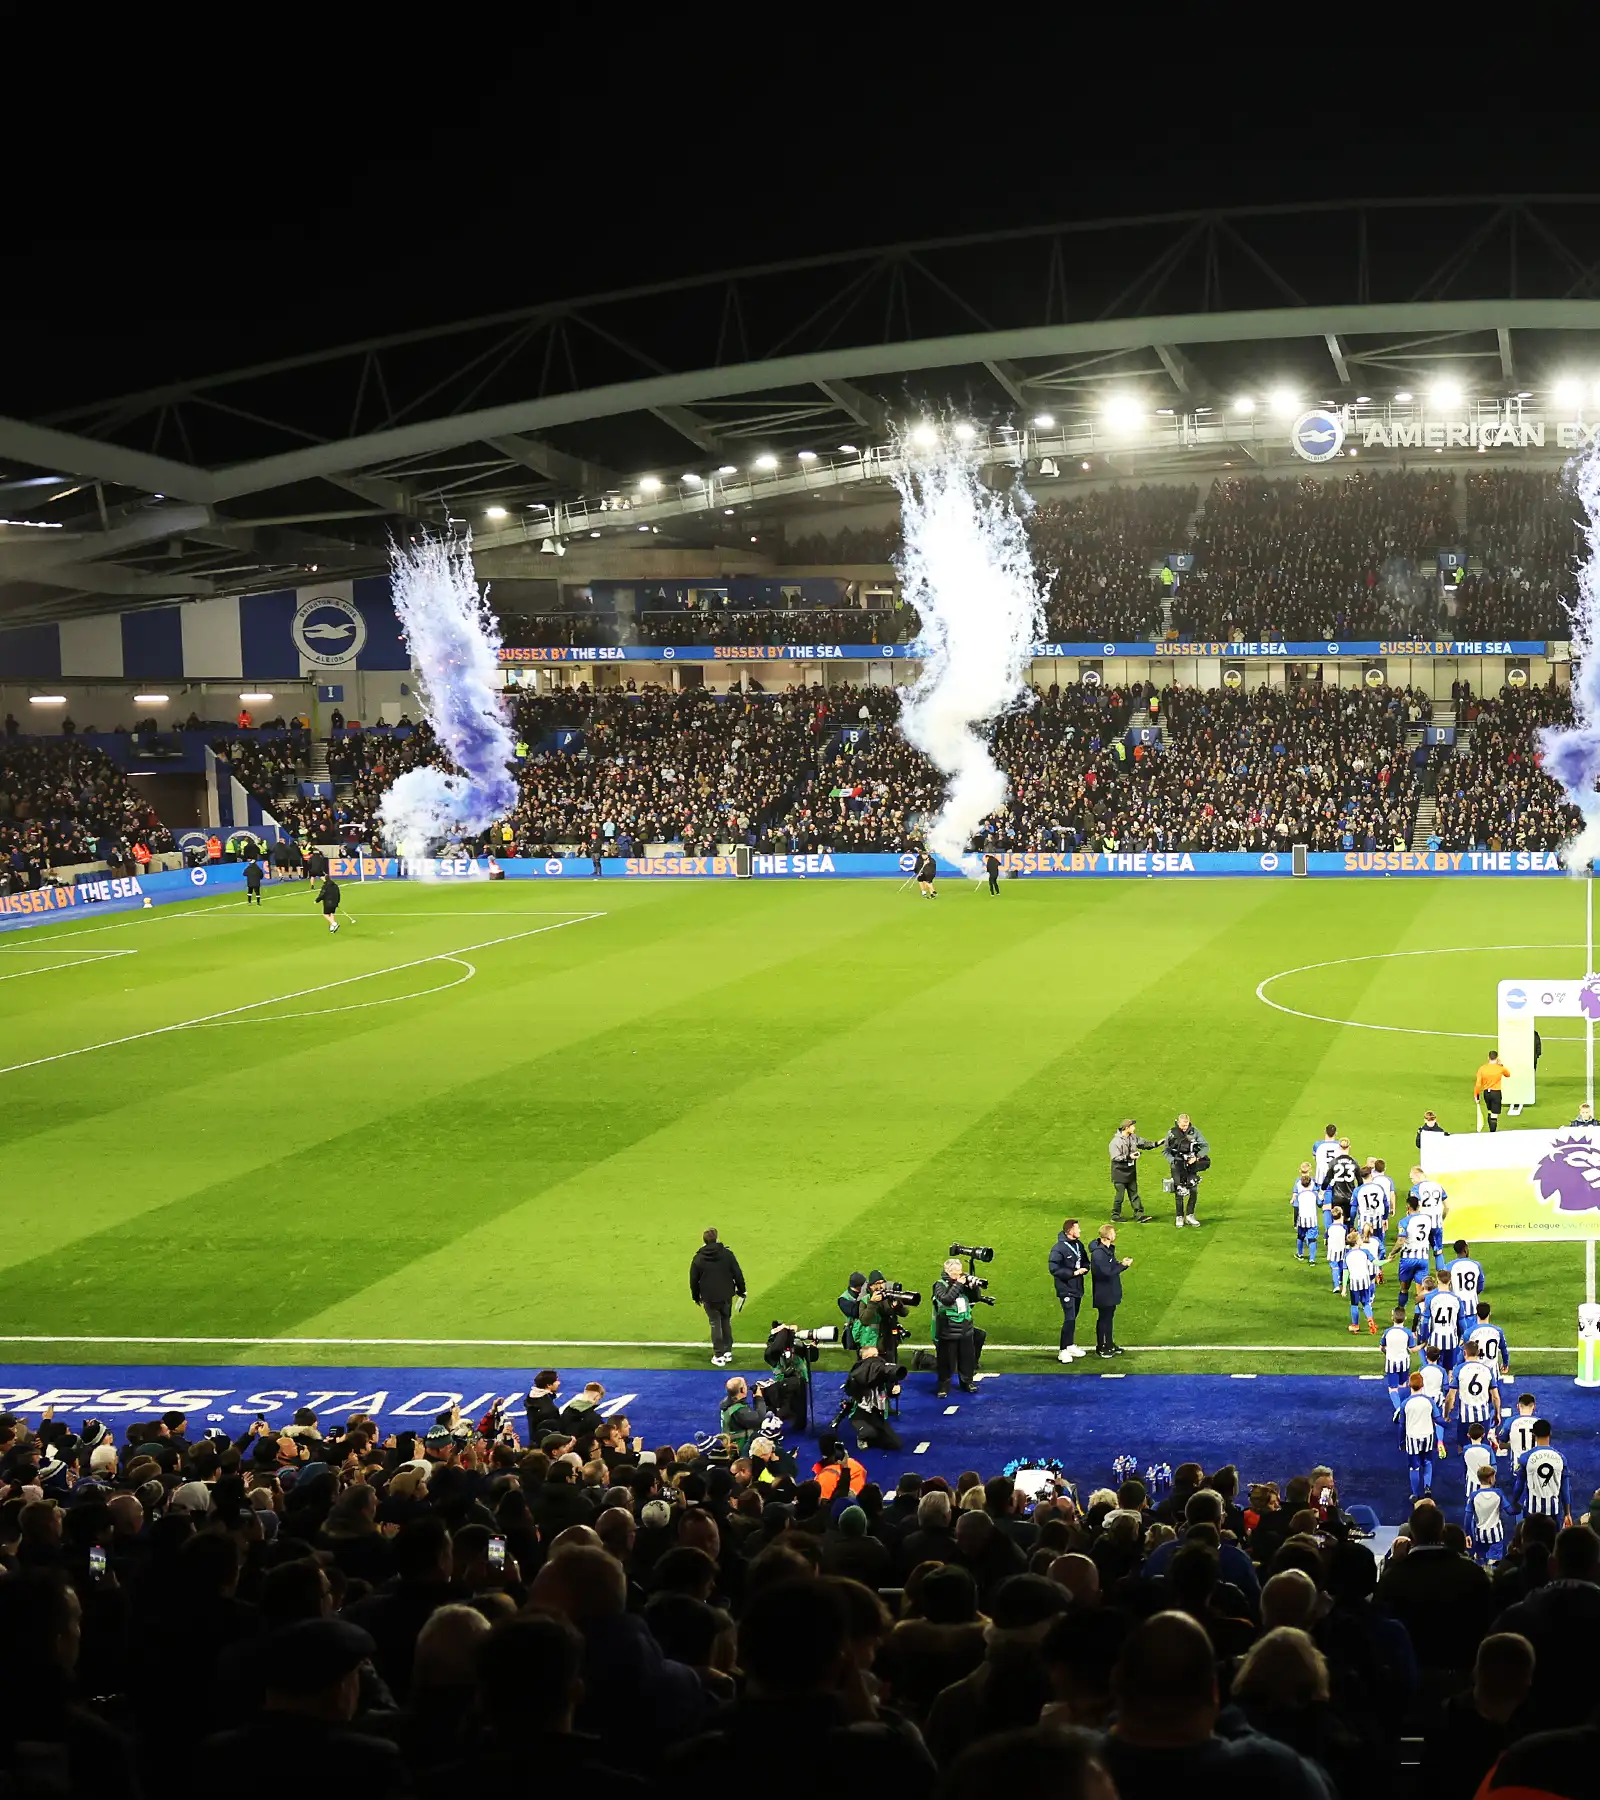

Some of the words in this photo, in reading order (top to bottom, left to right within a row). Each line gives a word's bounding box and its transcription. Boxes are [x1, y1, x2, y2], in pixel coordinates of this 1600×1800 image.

[1363, 421, 1545, 448] AMERICAN
[1176, 555, 1186, 567] C
[1448, 554, 1458, 566] D
[498, 648, 548, 661] SUSSEX
[551, 648, 568, 660] BY
[570, 647, 597, 660] THE
[599, 647, 626, 660] SEA
[713, 645, 765, 659] SUSSEX
[767, 646, 785, 658] BY
[787, 645, 814, 658] THE
[816, 645, 843, 658] SEA
[1037, 643, 1065, 656] SEA
[1155, 642, 1207, 655] SUSSEX
[1210, 642, 1229, 655] BY
[1230, 642, 1258, 655] THE
[1260, 642, 1288, 655] SEA
[1379, 641, 1431, 655] SUSSEX
[1434, 641, 1453, 654] BY
[1455, 641, 1483, 654] THE
[1485, 641, 1512, 654] SEA
[849, 730, 860, 743] B
[1140, 729, 1151, 742] C
[1436, 728, 1447, 741] D
[363, 858, 389, 876] BY
[440, 858, 481, 876] SEA
[626, 857, 708, 876] SUSSEX
[792, 854, 836, 873] SEA
[982, 853, 1063, 872] USSEX
[1071, 853, 1100, 872] BY
[1104, 853, 1147, 871] THE
[1152, 853, 1195, 871] SEA
[1344, 852, 1430, 871] SUSSEX
[1434, 852, 1463, 871] BY
[1468, 852, 1511, 871] THE
[1516, 852, 1559, 871] SEA
[55, 885, 76, 908] BY
[78, 880, 111, 902] THE
[111, 877, 143, 899] SEA
[1333, 1163, 1356, 1183] 23
[1363, 1192, 1380, 1211] 13
[1421, 1189, 1441, 1208] 29
[1415, 1223, 1426, 1241] 3
[1528, 1222, 1560, 1230] League
[1456, 1271, 1476, 1291] 18
[1434, 1306, 1453, 1327] 41
[1467, 1373, 1483, 1396] 6
[1518, 1428, 1536, 1451] 11
[1536, 1462, 1555, 1488] 9
